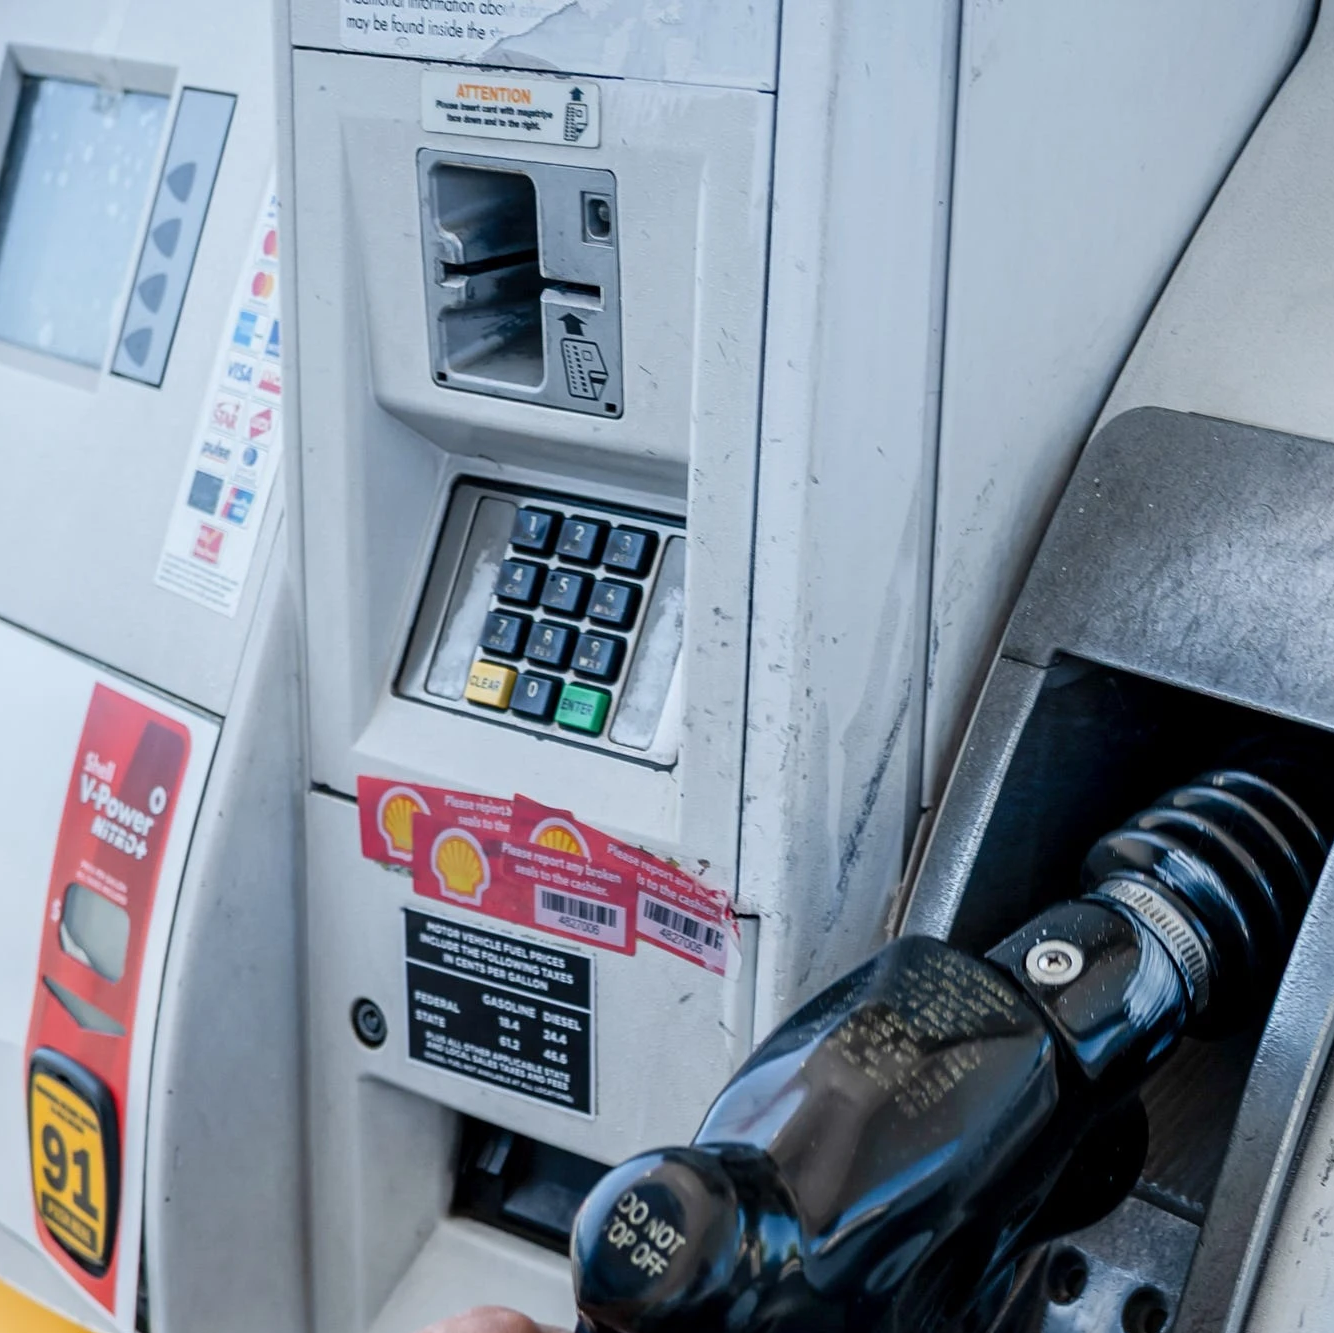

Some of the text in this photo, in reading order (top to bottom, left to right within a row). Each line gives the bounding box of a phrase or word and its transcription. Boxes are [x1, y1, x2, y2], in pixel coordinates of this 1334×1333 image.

[346, 16, 368, 34] may
[373, 13, 388, 32] be
[391, 14, 425, 36] found
[427, 19, 463, 38] inside
[466, 21, 486, 40] the
[456, 83, 532, 104] ATTENTION
[529, 515, 537, 532] 1
[575, 525, 585, 542] 2
[622, 535, 632, 552] 3
[512, 566, 523, 582] 4
[558, 578, 569, 594] 5
[605, 588, 616, 603] 6
[498, 619, 509, 634] 7
[542, 629, 554, 646] 8
[591, 640, 601, 657] 9
[469, 673, 502, 691] CLEAR
[527, 681, 538, 698] 0
[559, 697, 594, 717] ENTER
[83, 750, 116, 783] Shell
[444, 794, 474, 813] Please
[475, 800, 505, 817] report
[458, 814, 510, 833] seals to the
[501, 841, 532, 861] Please
[533, 850, 567, 870] report
[567, 859, 584, 877] any
[585, 863, 622, 885] broken
[606, 843, 641, 867] Please
[641, 861, 674, 884] report
[674, 875, 694, 893] any
[515, 863, 609, 898] seals to the cashier.
[646, 878, 659, 892] to
[659, 884, 677, 901] the
[558, 915, 600, 936] 4827006
[425, 921, 566, 970] MOTOR VEHICLE FUEL PRICES
[659, 928, 704, 955] 4827005
[419, 932, 574, 985] INCLUDE THE FOLLOWING TAXES
[442, 953, 549, 992] IN CENTS PER GALLON
[414, 990, 568, 1046] FEDERAL 18.4 24.4
[481, 993, 583, 1032] GASOLINE DIESEL
[414, 1009, 447, 1029] STATE
[498, 1034, 521, 1051] 61.2
[424, 1030, 571, 1084] PLUS ALL OTHER APPLICABLE STATE
[425, 1040, 570, 1092] AND LOCAL SALES TAXES AND FEES
[42, 1123, 99, 1222] 91
[617, 1190, 687, 1256] DO NOT
[630, 1242, 669, 1278] OFF
